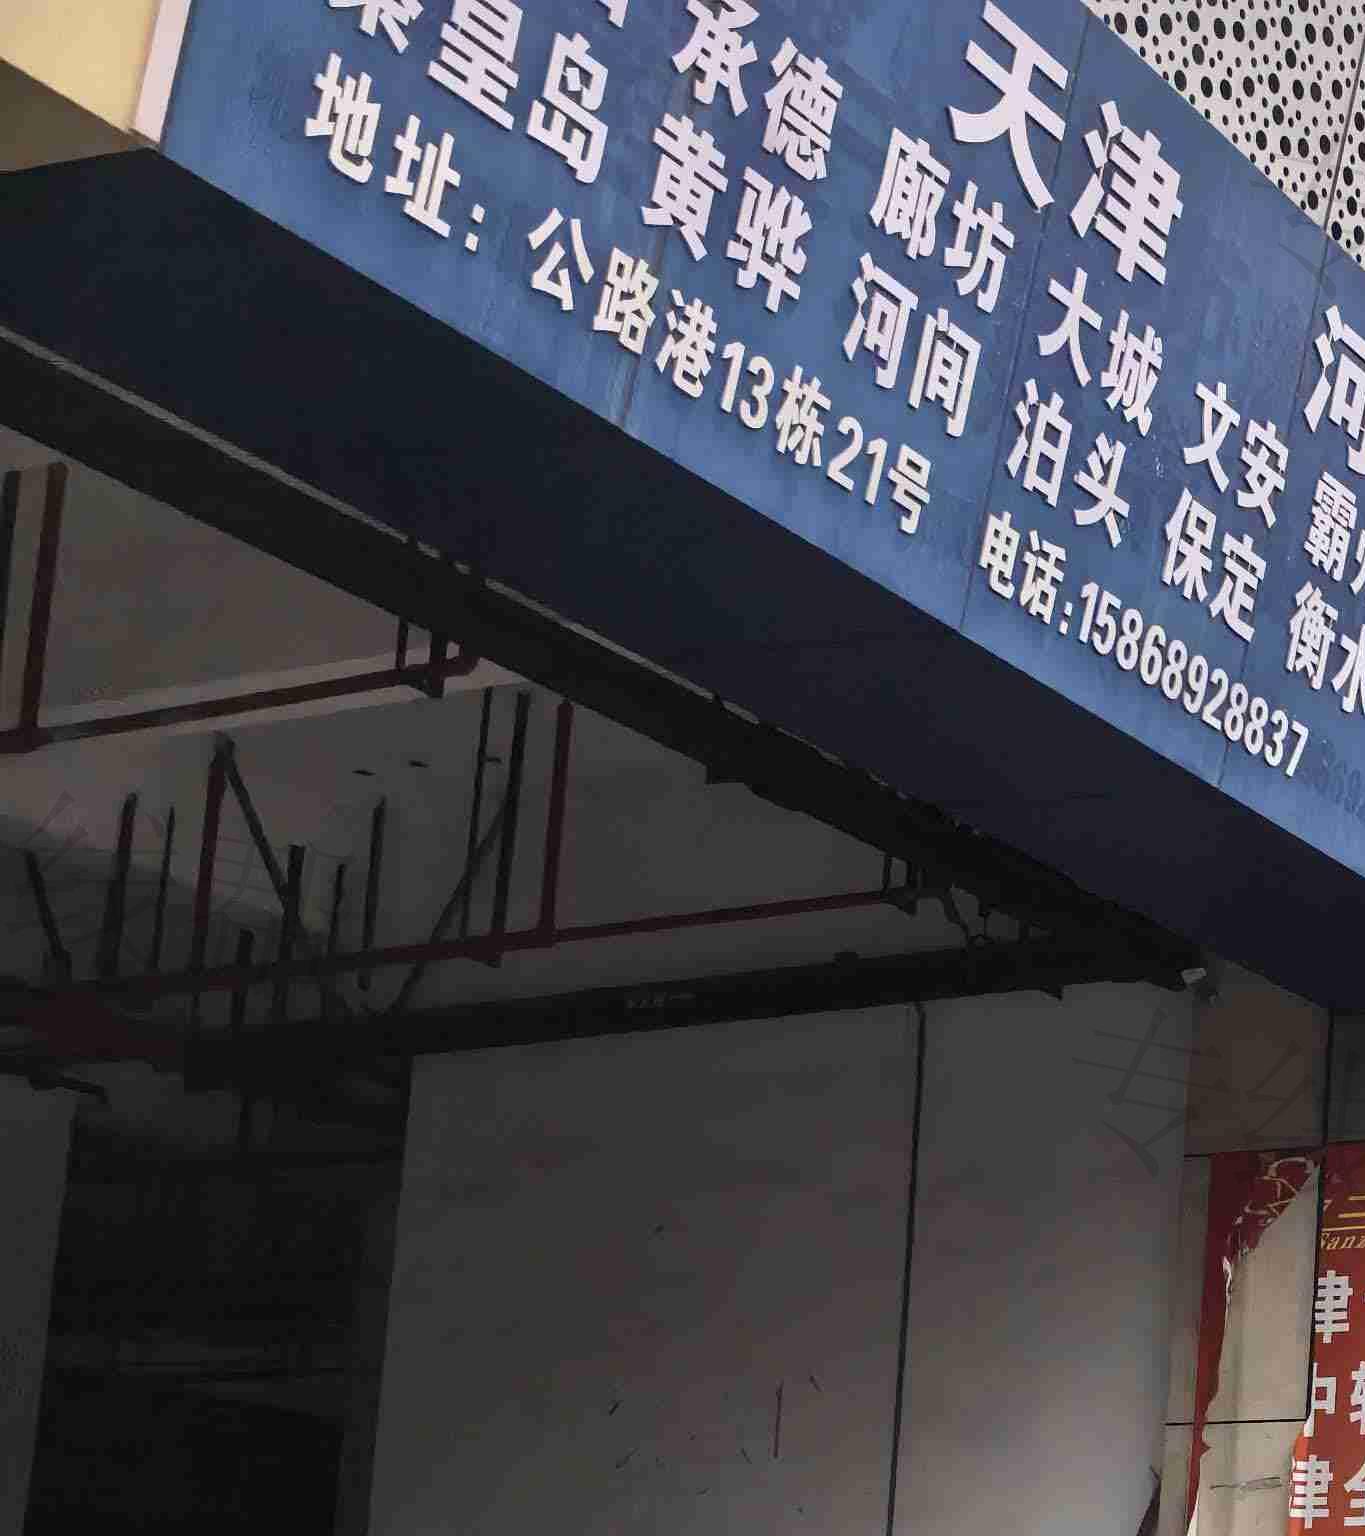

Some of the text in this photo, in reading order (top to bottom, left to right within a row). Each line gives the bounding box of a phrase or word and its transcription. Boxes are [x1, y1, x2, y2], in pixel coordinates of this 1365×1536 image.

[641, 112, 813, 314] 黄骅
[843, 252, 982, 438] 河间
[1005, 378, 1132, 548] 泊头
[1161, 487, 1268, 643] 保定
[673, 0, 843, 181] 承德
[868, 127, 1014, 313] 廊坊
[1037, 266, 1167, 437] 大城
[1182, 380, 1290, 529] 文安
[947, 0, 1184, 286] 天津
